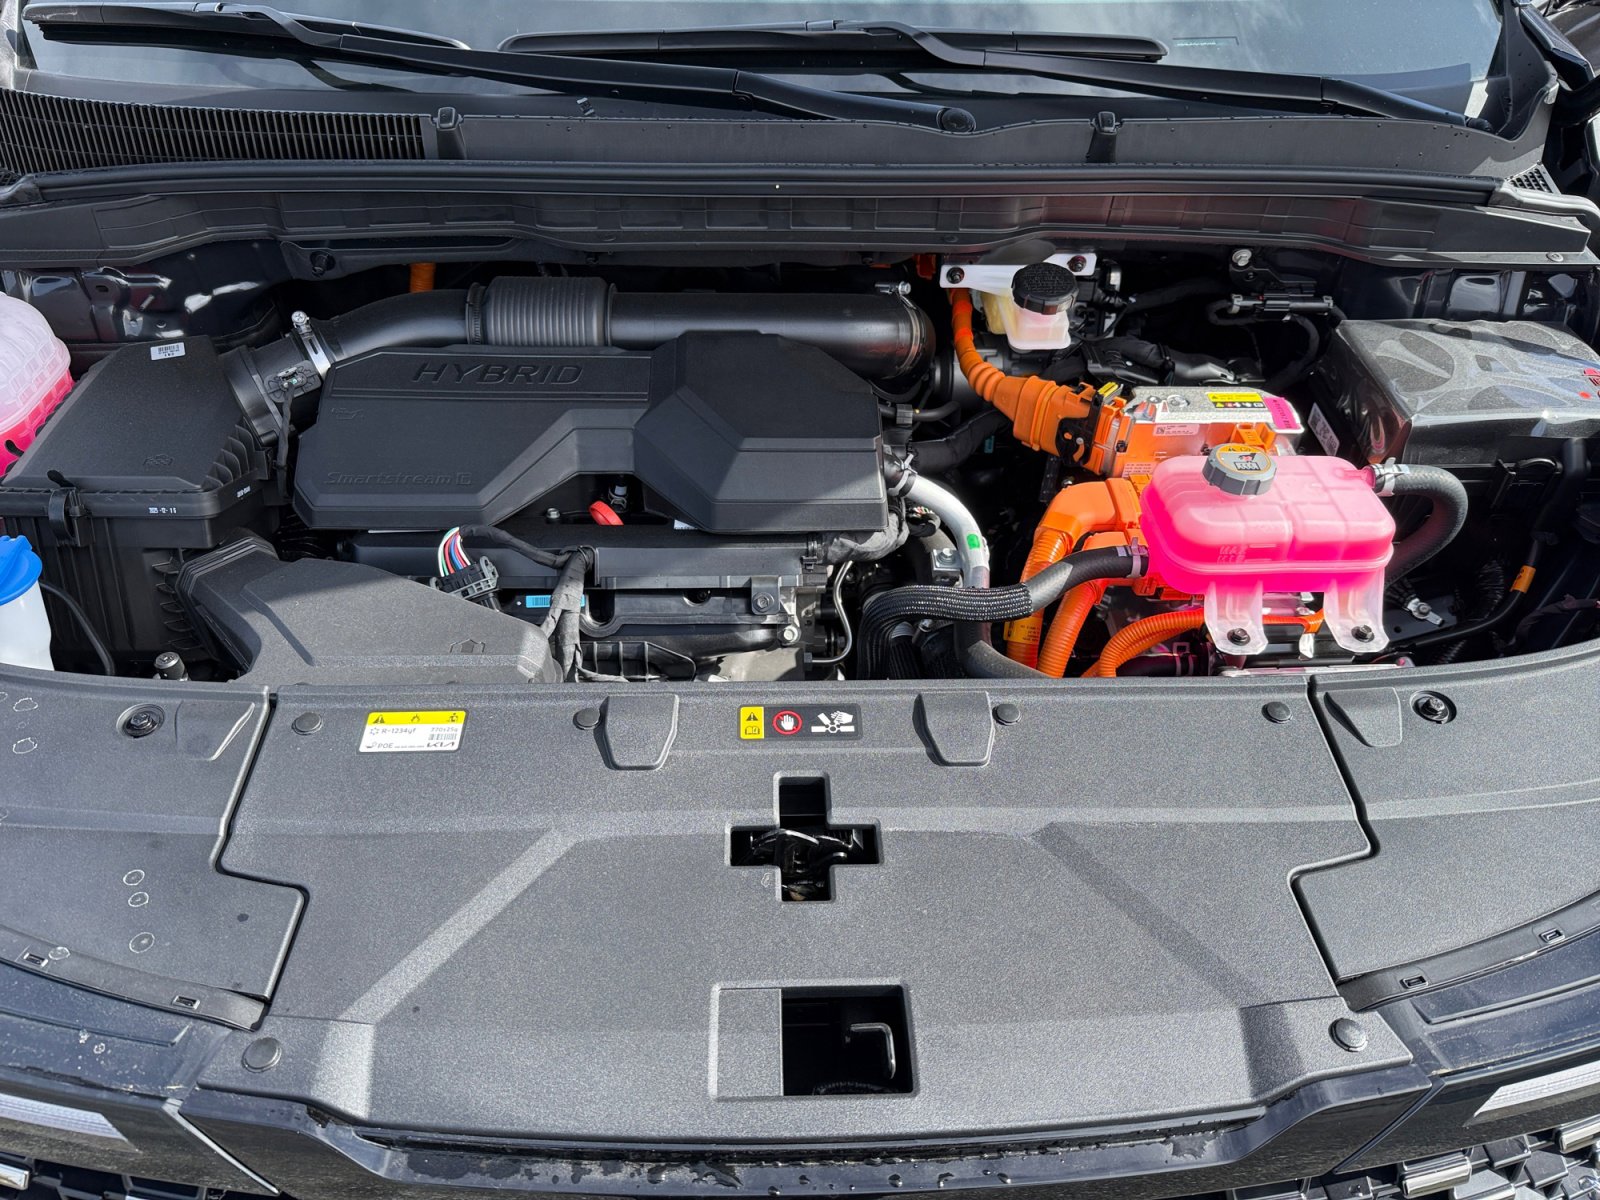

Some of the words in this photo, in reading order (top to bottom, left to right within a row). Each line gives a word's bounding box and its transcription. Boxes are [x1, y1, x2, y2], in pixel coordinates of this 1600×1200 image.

[411, 361, 584, 385] HYBRID
[323, 471, 451, 486] Smartstream
[381, 727, 417, 735] R-1234yf
